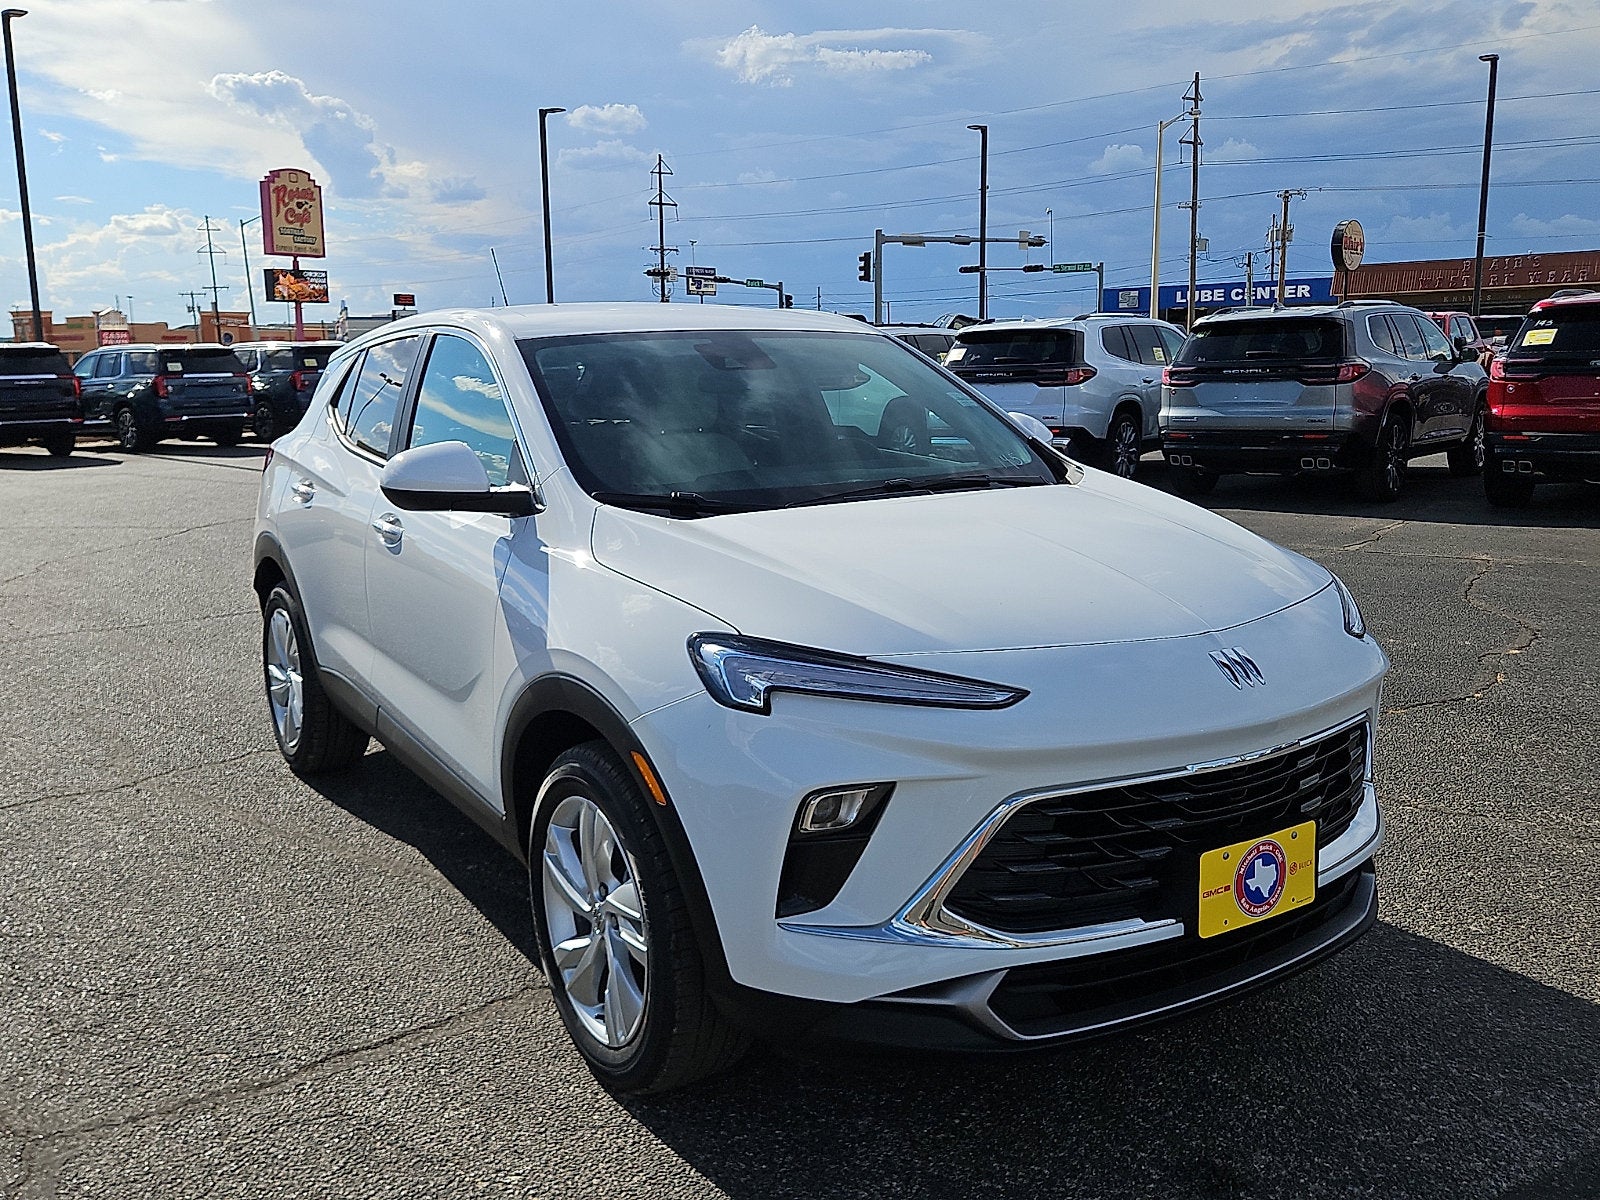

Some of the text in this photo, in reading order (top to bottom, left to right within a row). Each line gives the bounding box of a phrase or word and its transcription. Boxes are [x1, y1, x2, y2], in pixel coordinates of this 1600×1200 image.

[1527, 269, 1588, 283] WEAR
[1443, 295, 1491, 303] KNIVS
[1202, 886, 1224, 899] GMC
